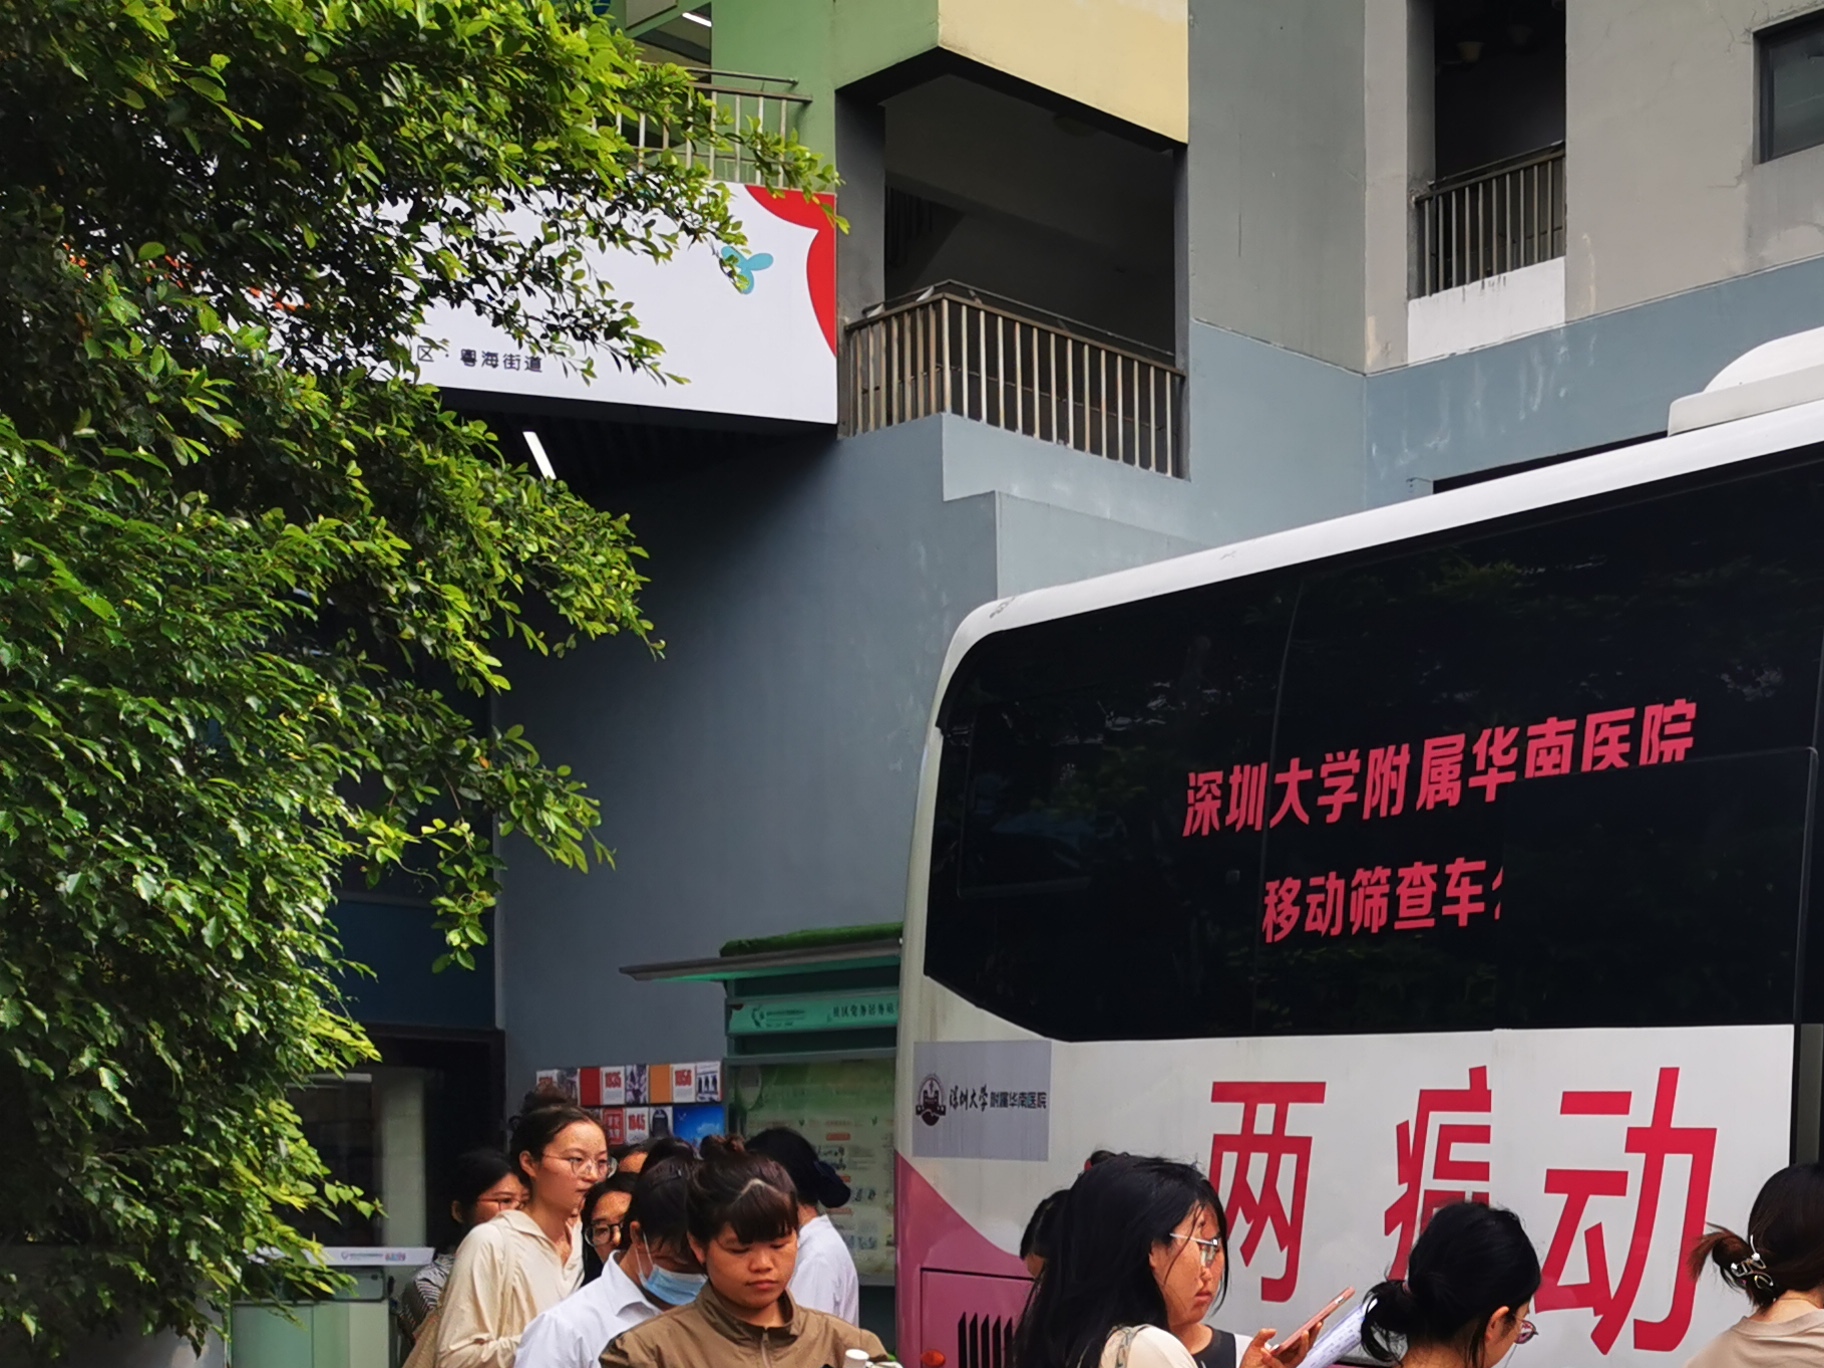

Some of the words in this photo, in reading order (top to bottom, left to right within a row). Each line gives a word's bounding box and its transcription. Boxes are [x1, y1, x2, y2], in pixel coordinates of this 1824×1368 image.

[1182, 698, 1698, 838] 深圳大学附属华南医院
[1261, 856, 1506, 945] 移动筛查车
